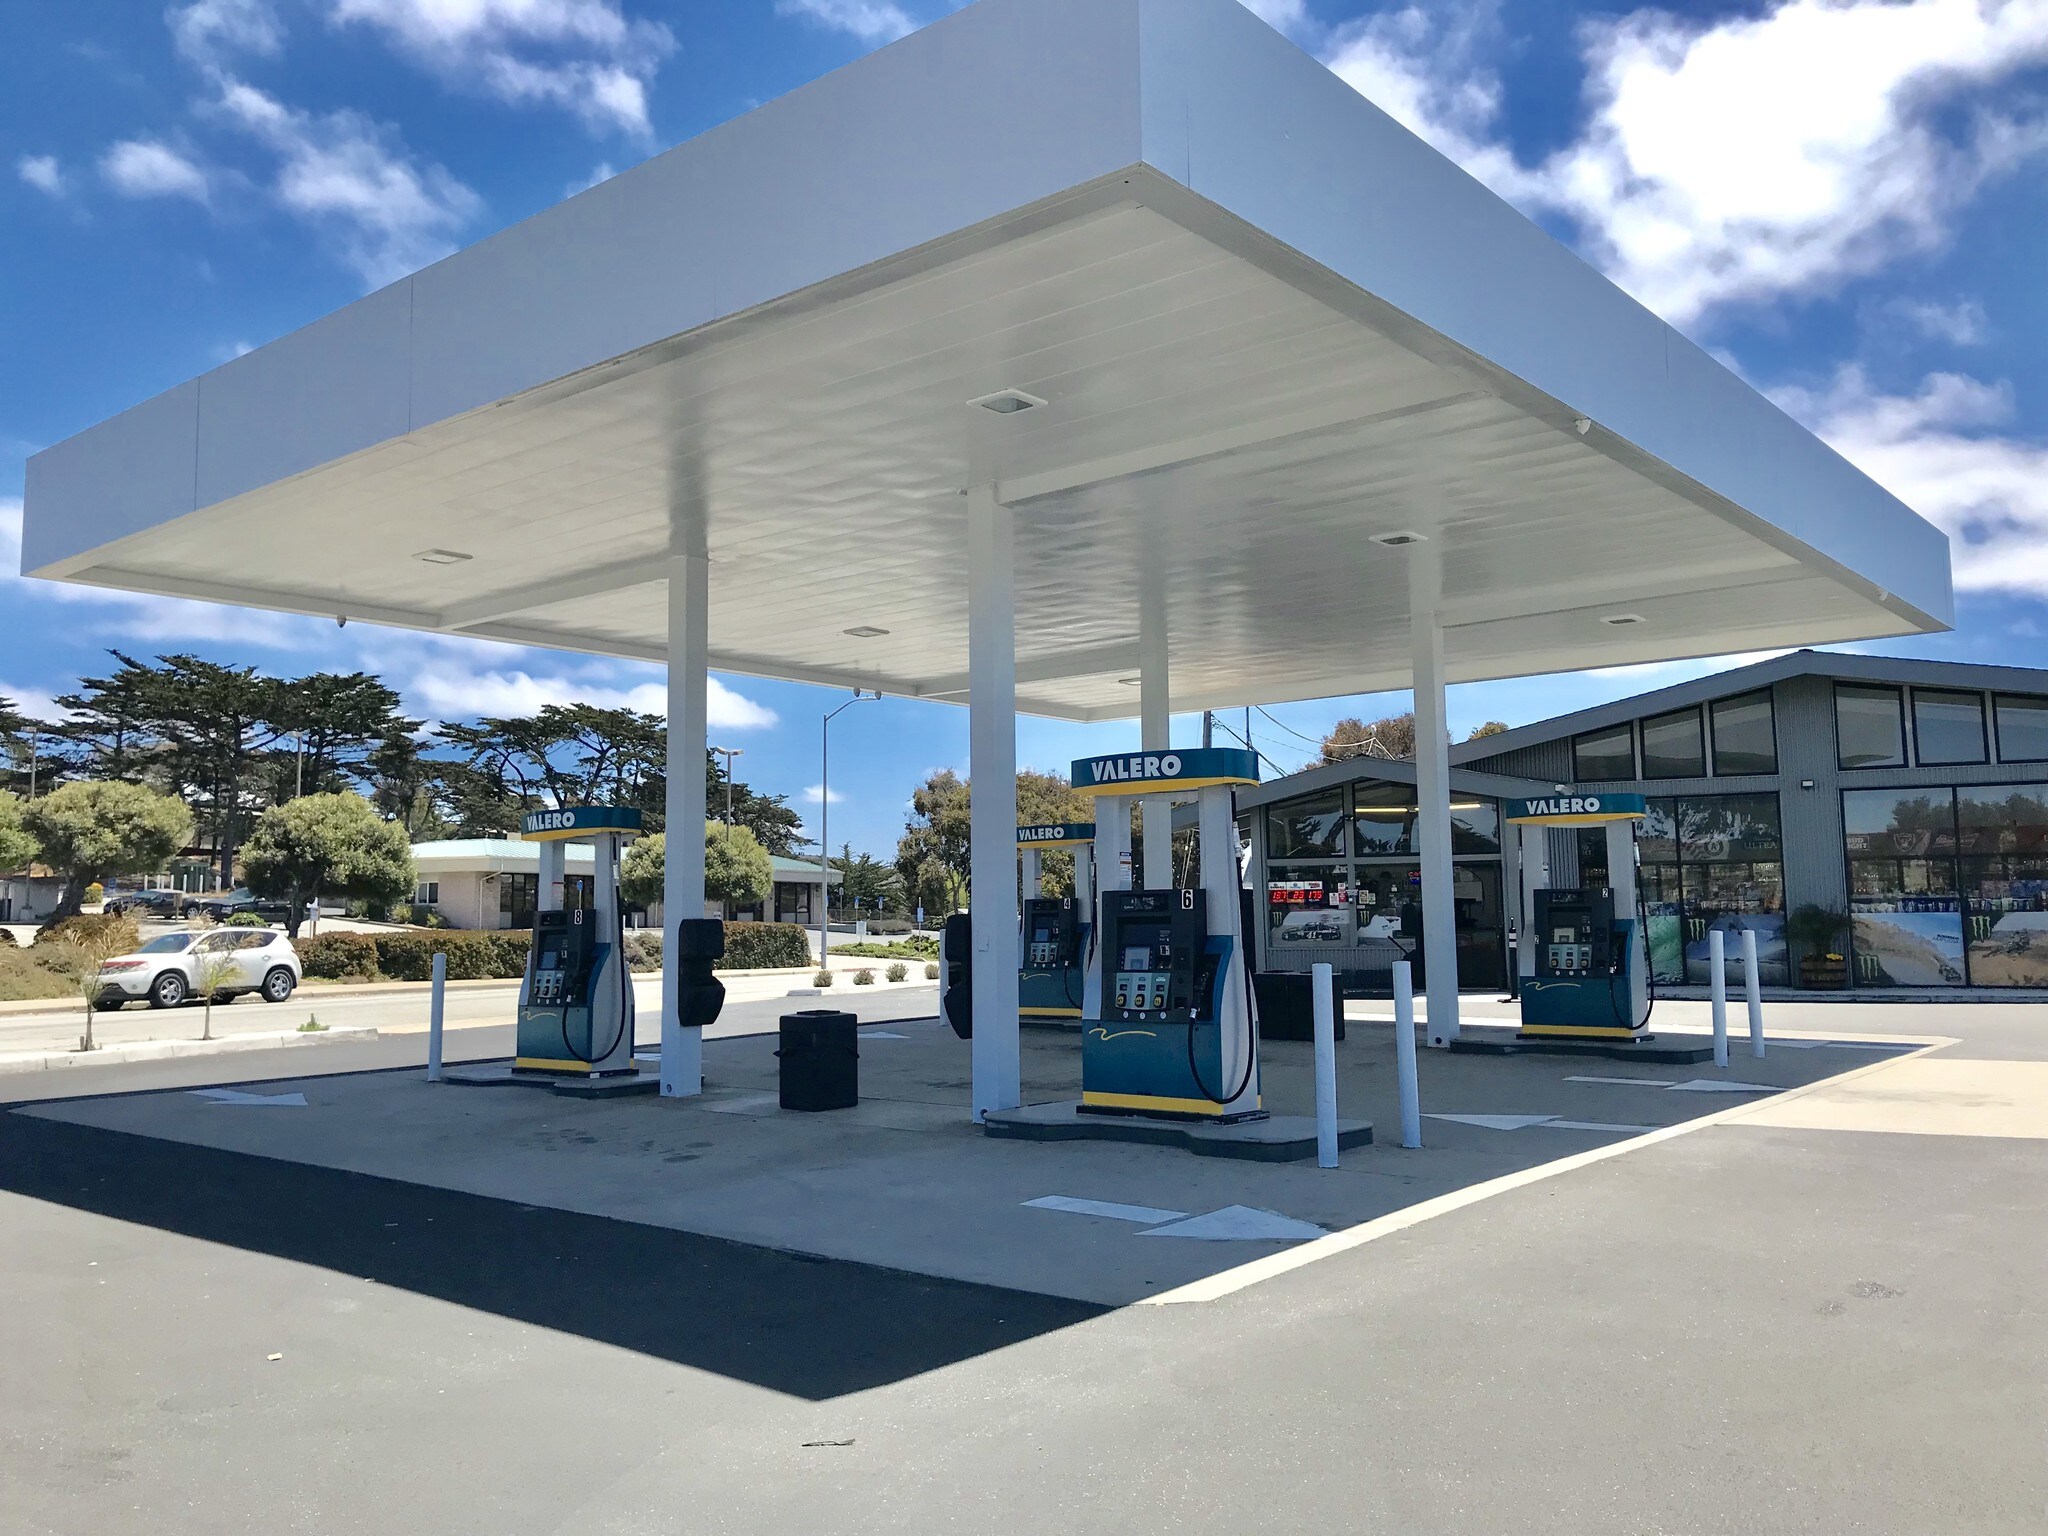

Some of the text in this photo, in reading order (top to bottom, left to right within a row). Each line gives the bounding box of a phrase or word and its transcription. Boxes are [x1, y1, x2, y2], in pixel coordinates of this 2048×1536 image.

[1090, 754, 1182, 782] VALERO
[1525, 797, 1600, 815] VALERO
[526, 811, 576, 832] VALERO
[1018, 826, 1065, 841] VALERO
[1183, 890, 1192, 909] 6
[1602, 888, 1609, 898] 2
[1064, 898, 1070, 909] 4
[575, 910, 582, 924] 8
